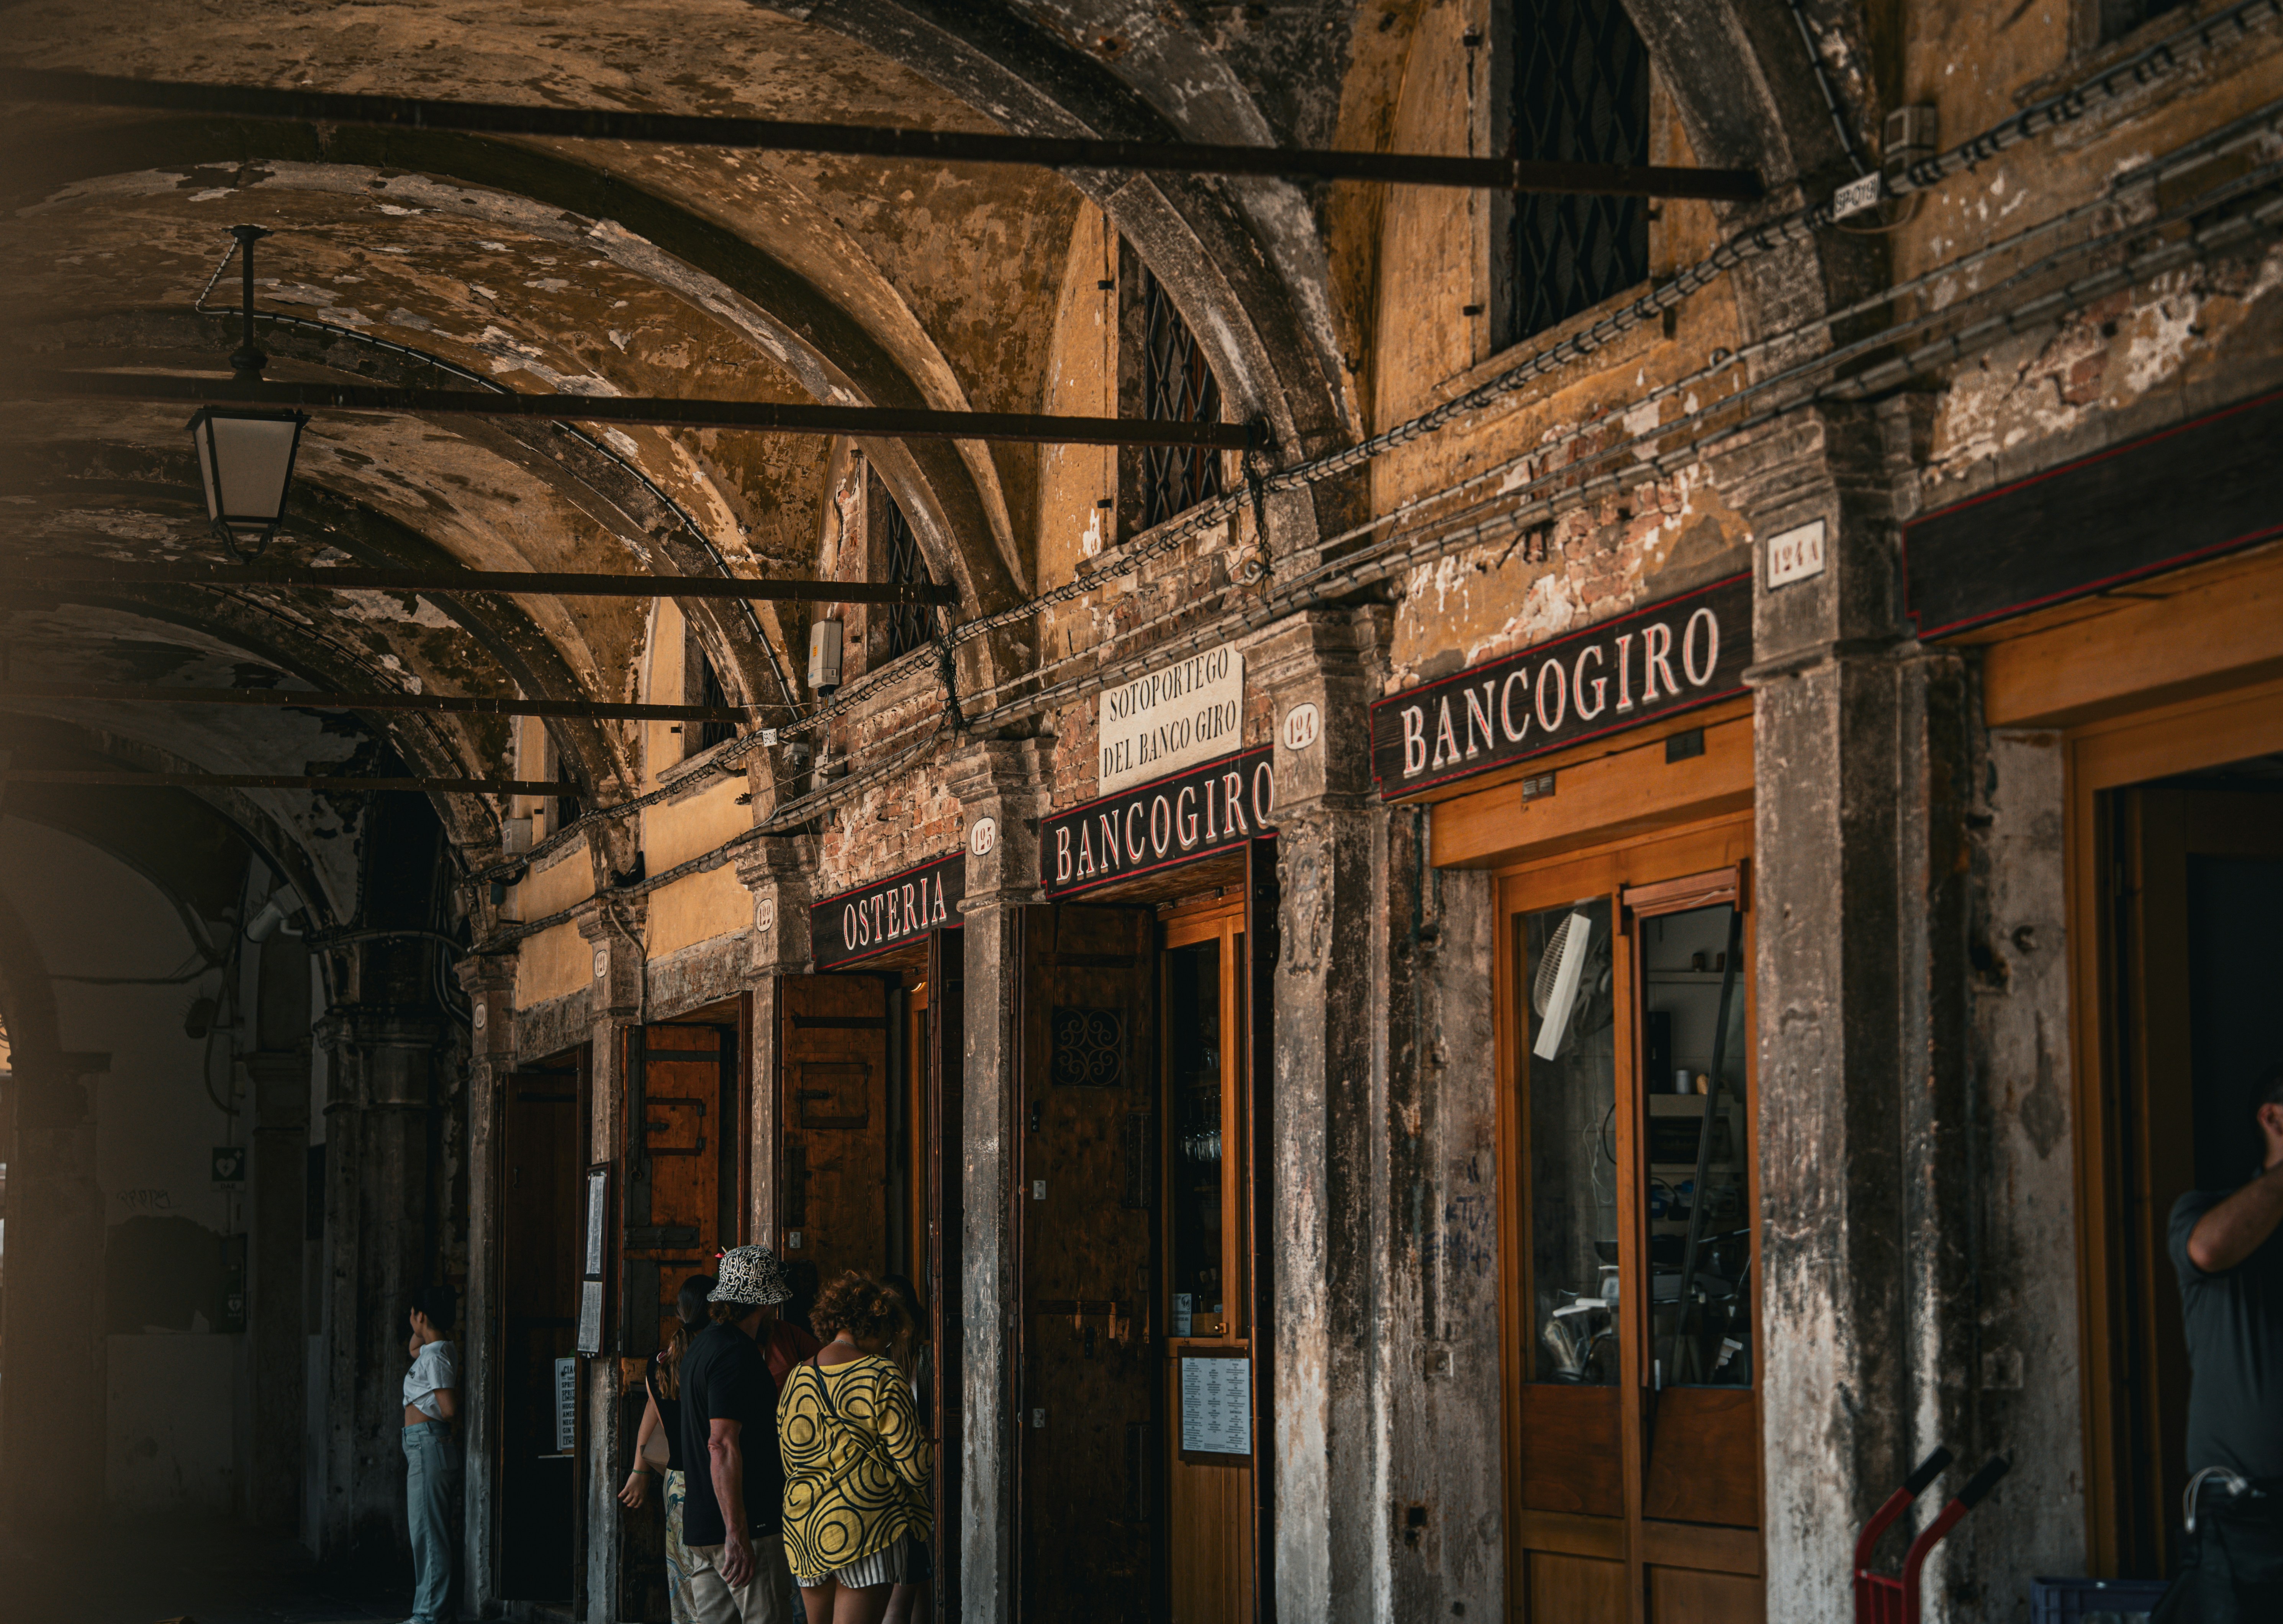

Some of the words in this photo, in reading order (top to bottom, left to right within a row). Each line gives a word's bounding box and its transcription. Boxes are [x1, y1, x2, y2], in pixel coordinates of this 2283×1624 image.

[1110, 648, 1227, 722] SOTOPORTEGO
[1400, 607, 1719, 779] BANCOGIRO
[1104, 738, 1133, 778] DEL
[1139, 717, 1189, 765] BANCO
[1196, 700, 1236, 742] GIRO
[1290, 712, 1312, 744] 124
[1056, 761, 1274, 884] BANCOGIRO
[760, 905, 770, 926] 122
[843, 871, 947, 951] OSTERIA
